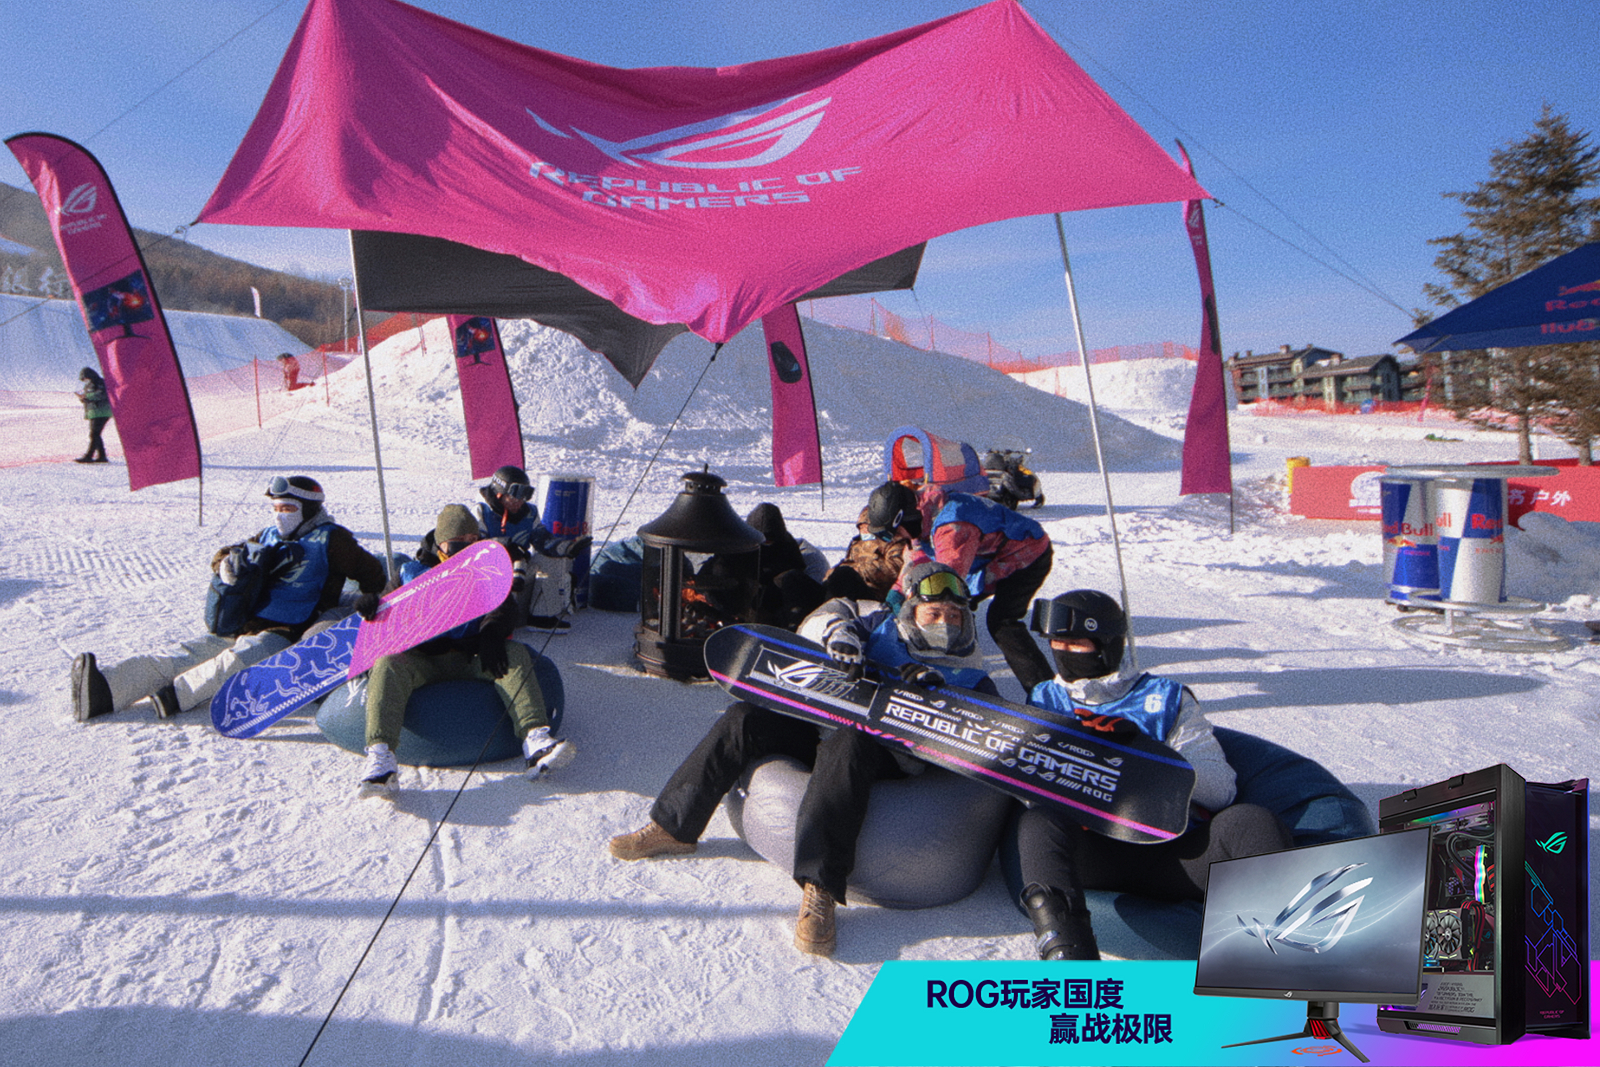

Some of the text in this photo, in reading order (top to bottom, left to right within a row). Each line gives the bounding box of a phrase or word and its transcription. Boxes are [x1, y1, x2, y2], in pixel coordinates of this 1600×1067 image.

[529, 162, 862, 192] REPUBLIC OF
[582, 190, 811, 210] GAMERS
[552, 520, 580, 536] Red
[1401, 522, 1434, 537] Bull
[1143, 693, 1163, 714] 6
[884, 701, 1119, 792] REPUBLIC OF GAMERS
[1082, 785, 1113, 803] ROG
